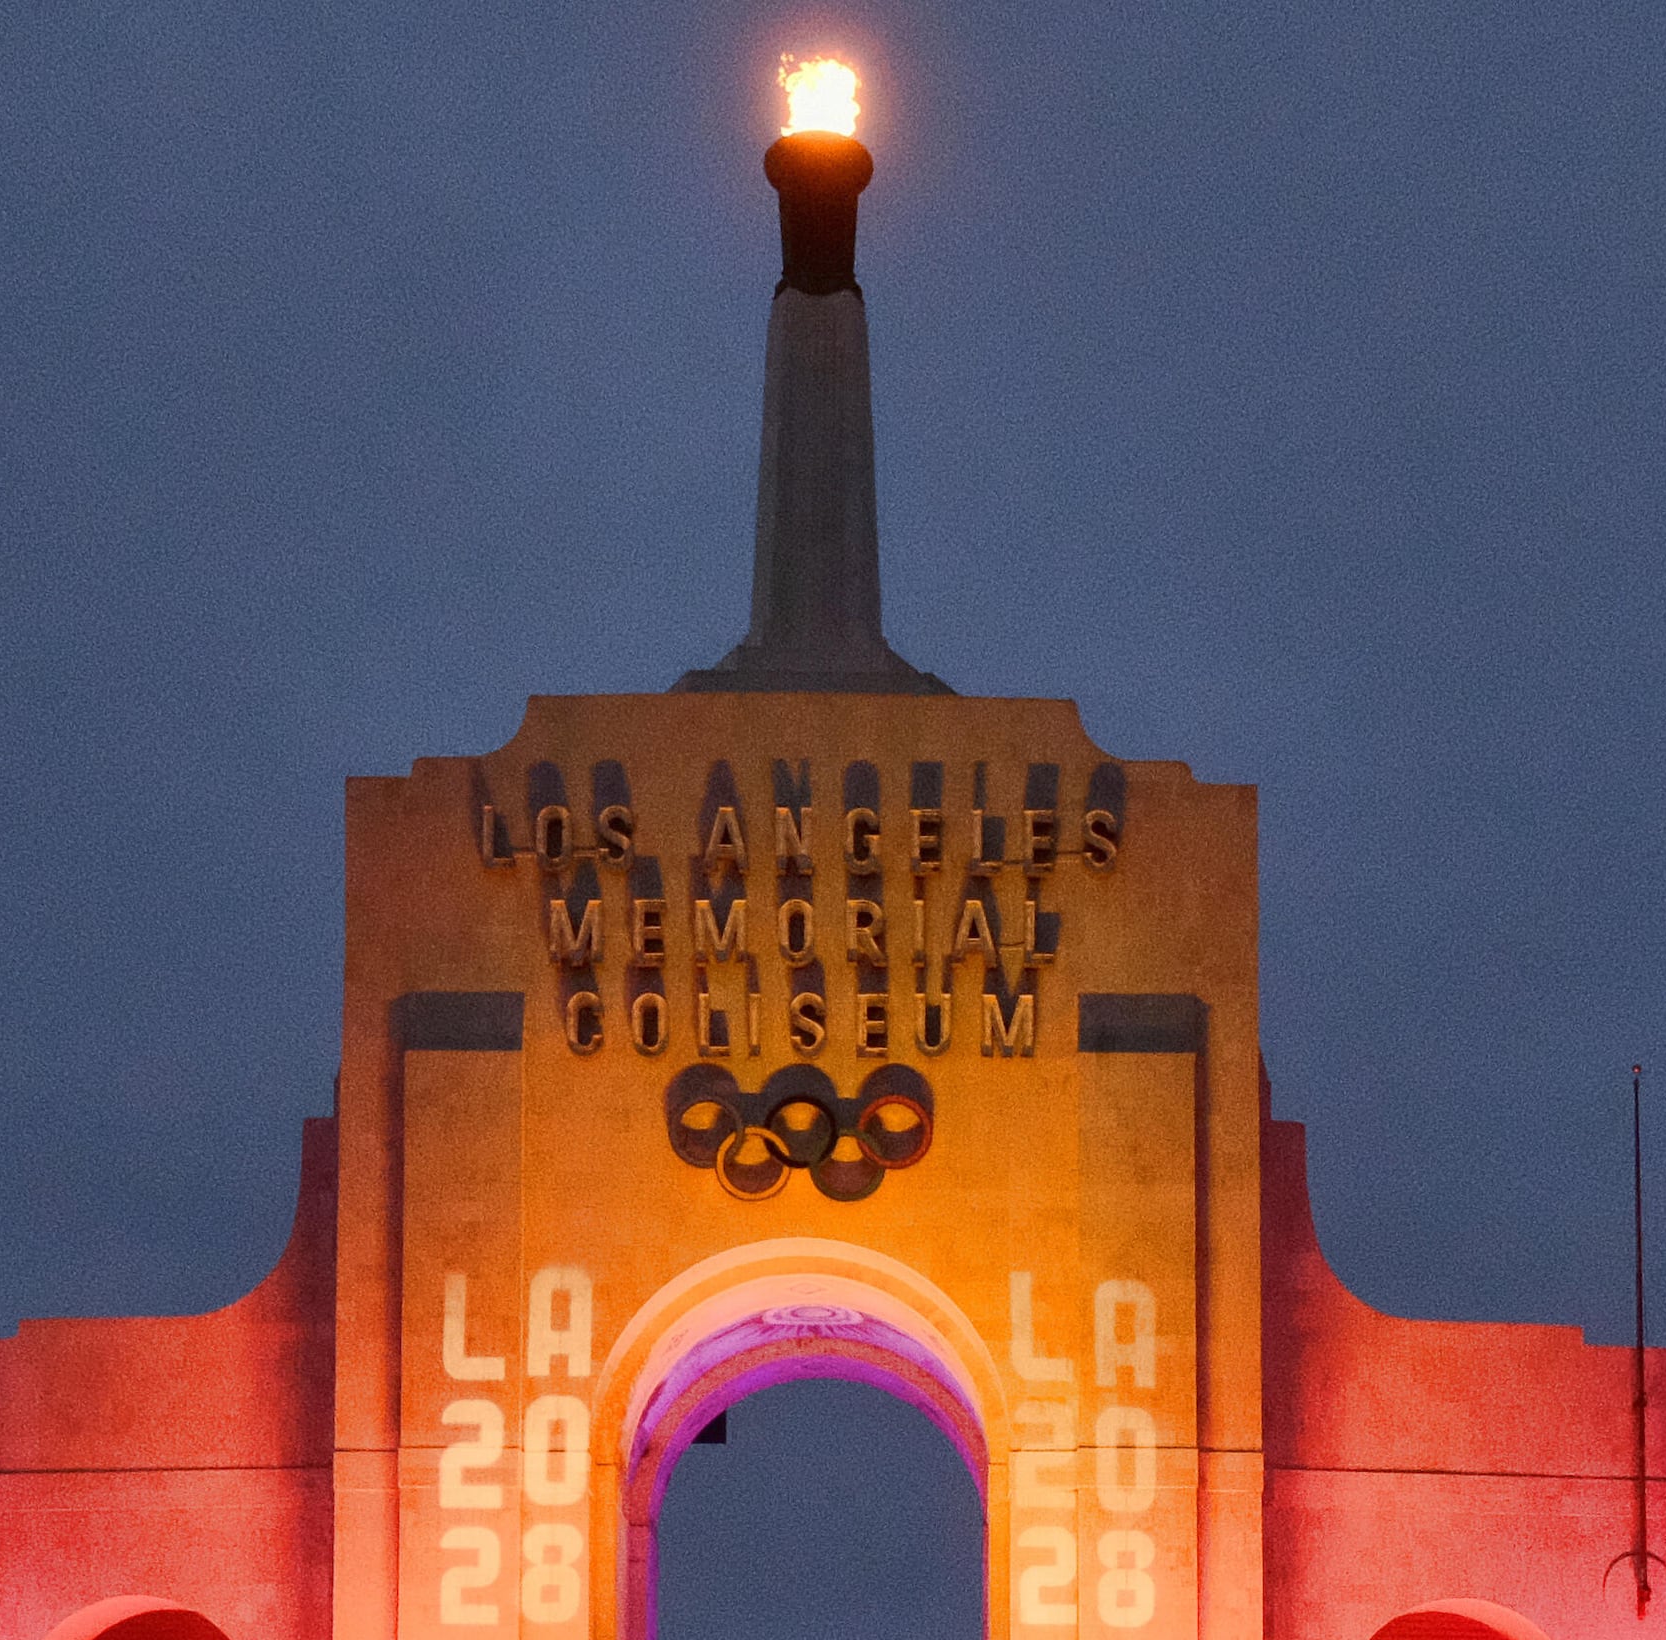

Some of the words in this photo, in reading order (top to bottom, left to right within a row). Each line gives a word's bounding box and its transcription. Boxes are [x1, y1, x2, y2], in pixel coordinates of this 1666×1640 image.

[481, 805, 635, 871] LOS
[706, 805, 1121, 875] ANGELES
[547, 898, 1055, 969] MEMORIAL
[565, 990, 1037, 1058] COLISEUM
[440, 1266, 594, 1382] LA
[1008, 1270, 1158, 1389] LA
[437, 1394, 592, 1509] 20
[1010, 1398, 1158, 1513] 20
[438, 1522, 583, 1627] 28
[1016, 1526, 1157, 1629] 28
